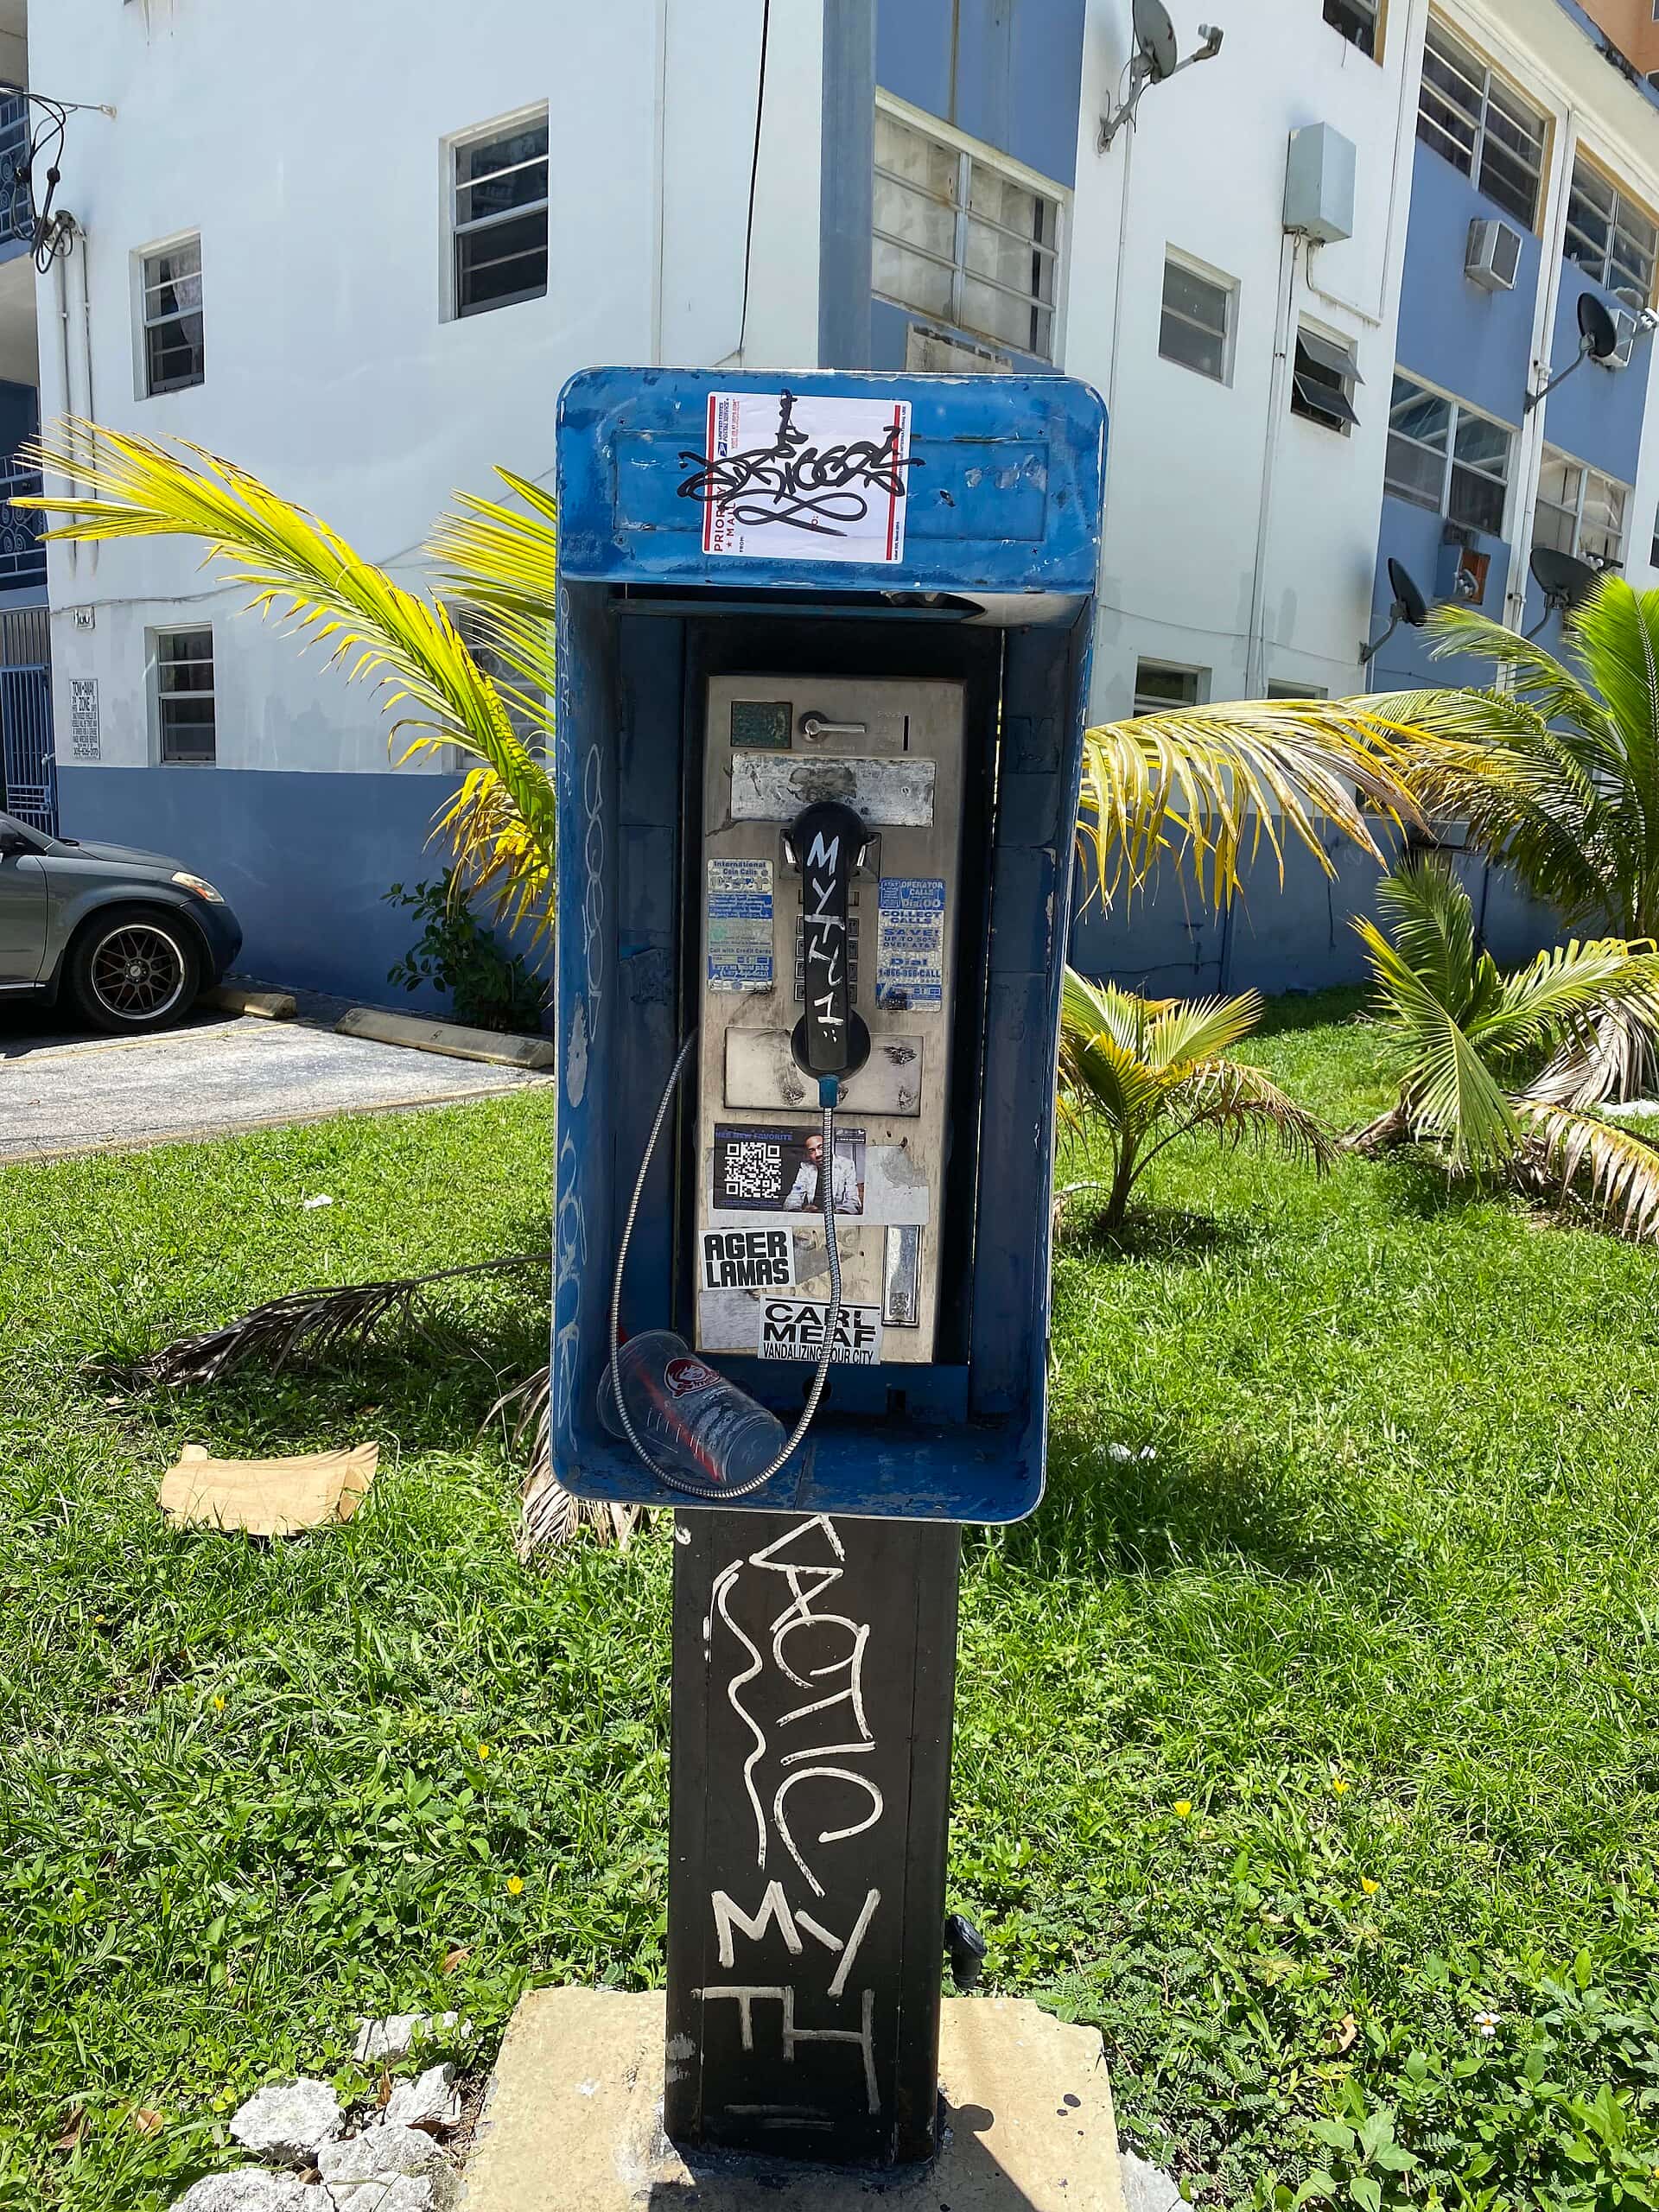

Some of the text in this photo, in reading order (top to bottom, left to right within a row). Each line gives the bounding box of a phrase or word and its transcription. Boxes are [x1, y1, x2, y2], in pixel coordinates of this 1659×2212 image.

[713, 486, 728, 552] PRIORY
[884, 928, 939, 937] SAVE!
[703, 1230, 788, 1262] AGER
[705, 1258, 790, 1288] LAMAS
[764, 1341, 874, 1365] VANDALIZING OUR CITY
